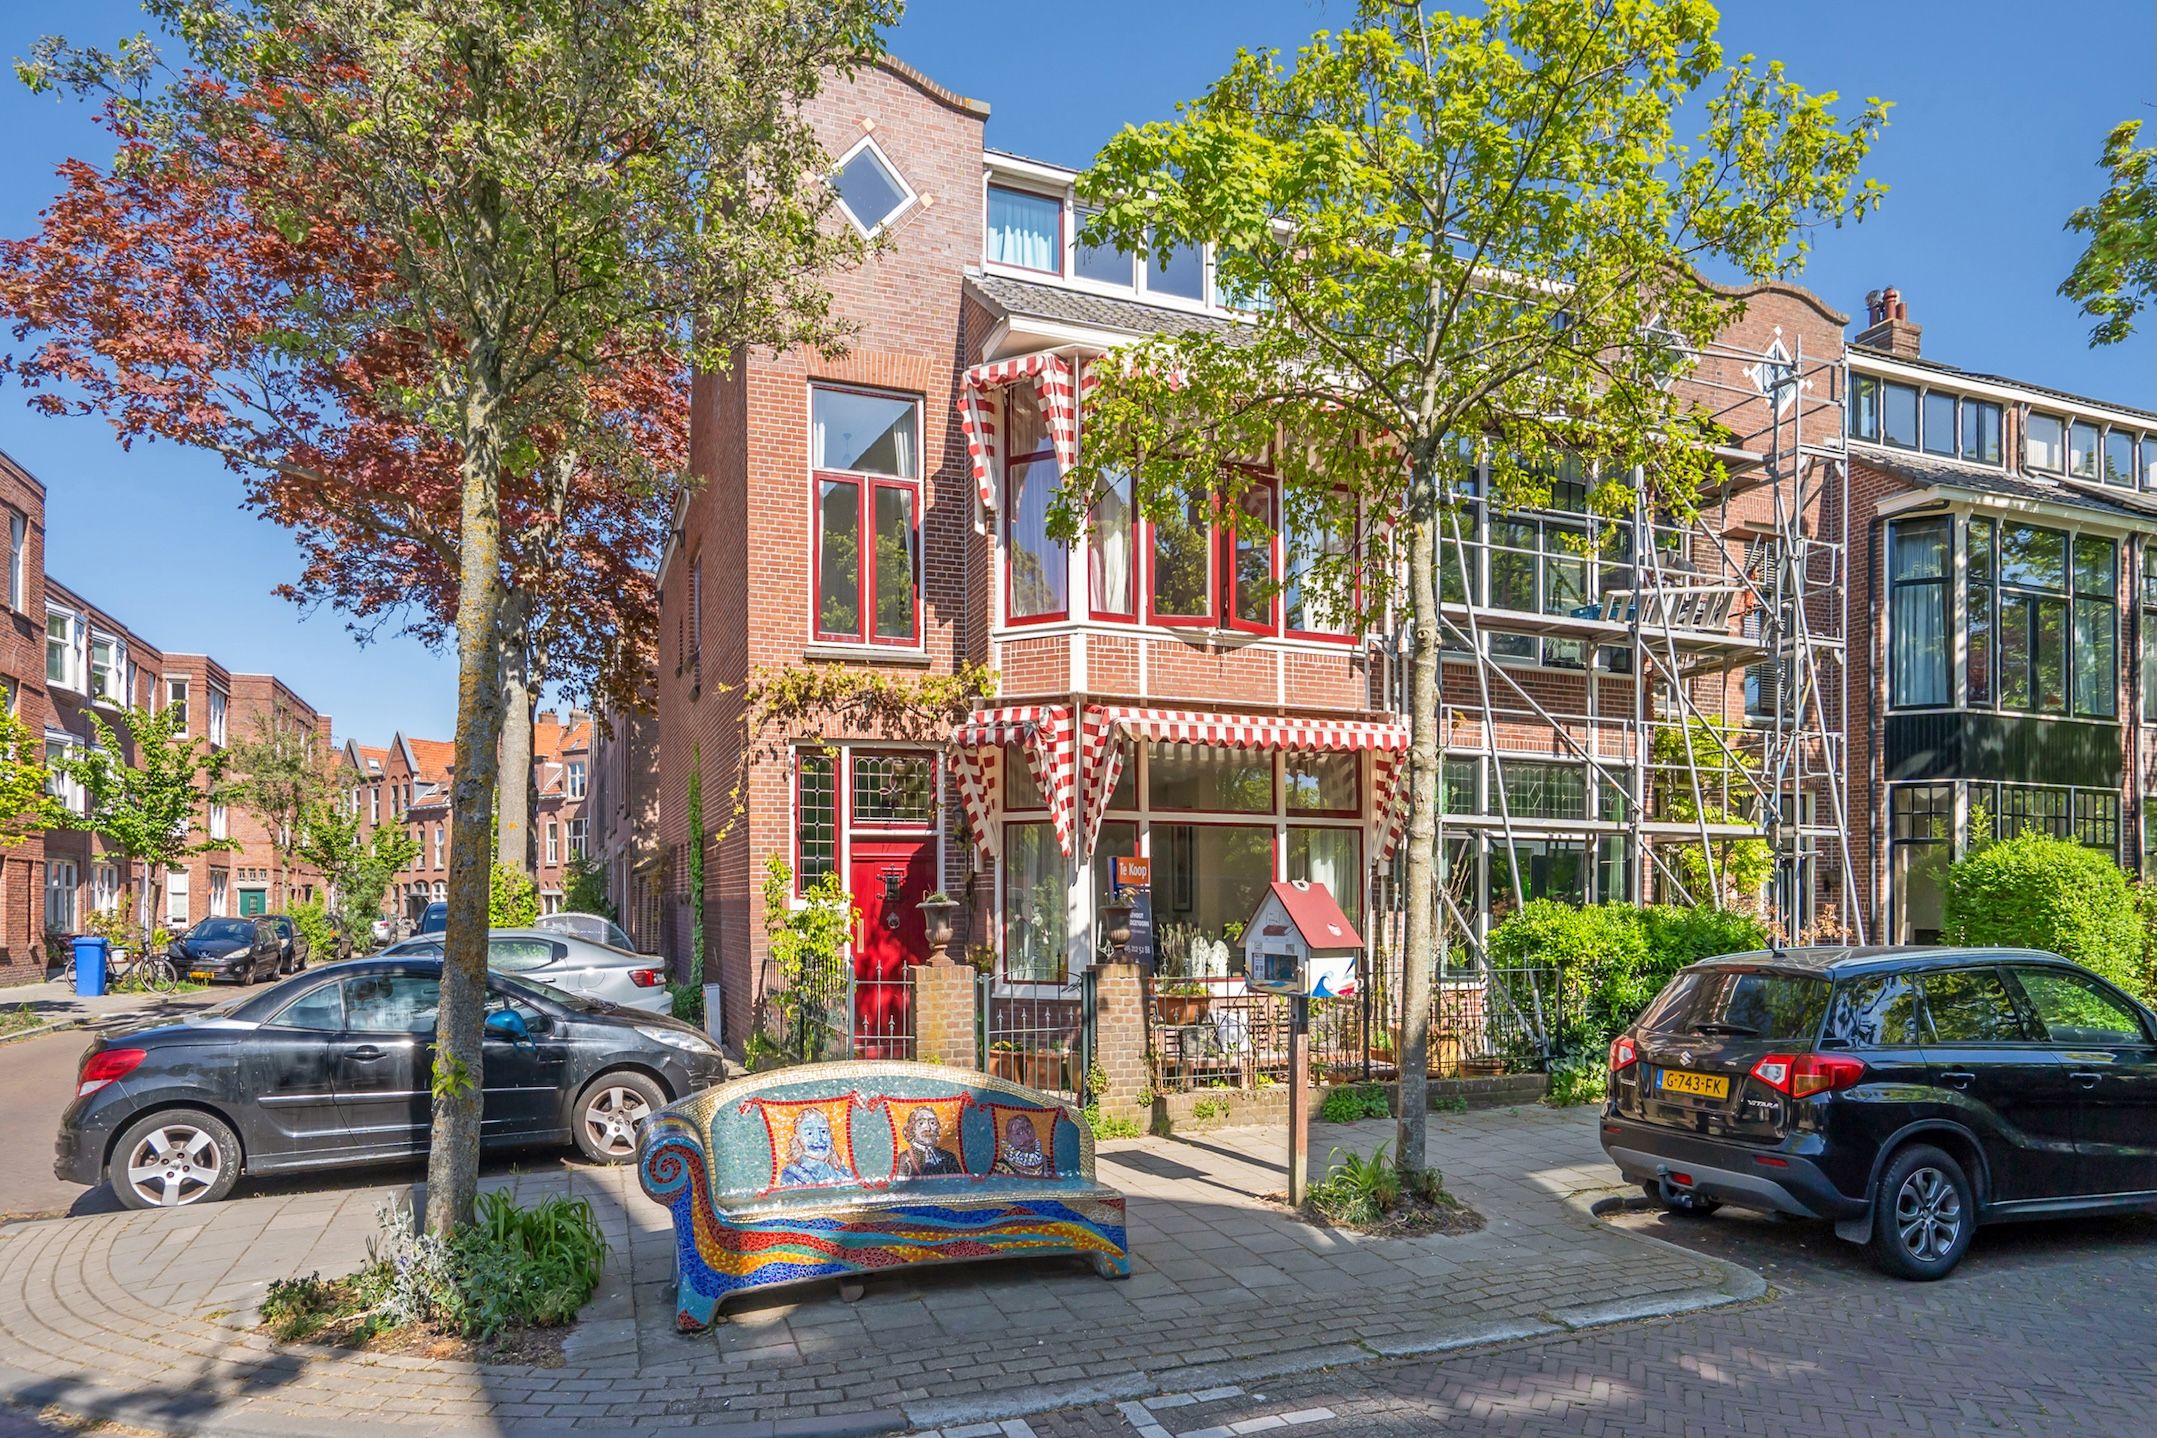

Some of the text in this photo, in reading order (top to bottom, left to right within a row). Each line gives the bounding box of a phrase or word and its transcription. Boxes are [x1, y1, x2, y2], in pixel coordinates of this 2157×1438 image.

[1119, 862, 1148, 880] Te Koop
[1667, 1073, 1722, 1095] G-743-FK
[1747, 1099, 1779, 1110] VITARA
